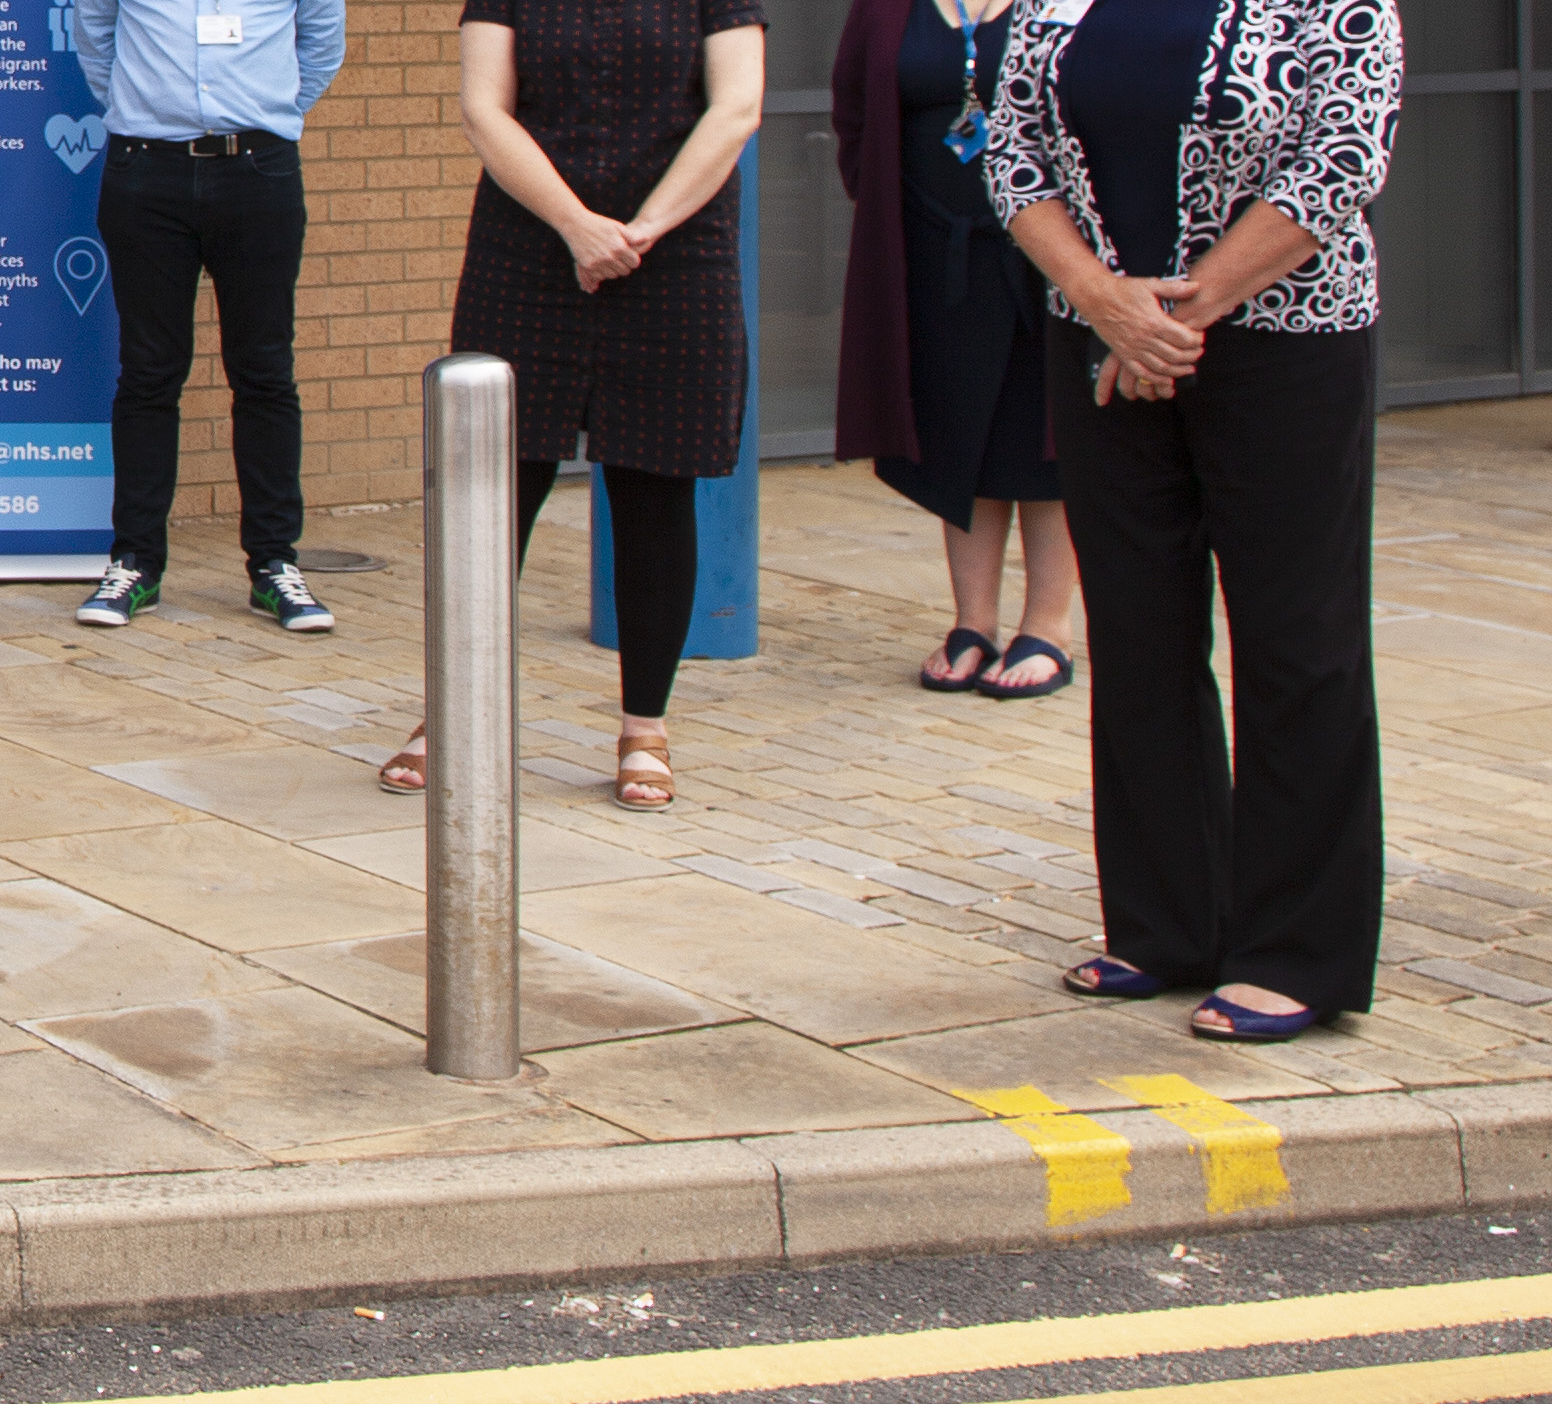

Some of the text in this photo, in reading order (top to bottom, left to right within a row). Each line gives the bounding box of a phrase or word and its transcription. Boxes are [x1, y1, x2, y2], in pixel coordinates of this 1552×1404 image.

[0, 38, 26, 51] the
[25, 357, 62, 374] may
[13, 379, 37, 392] us:
